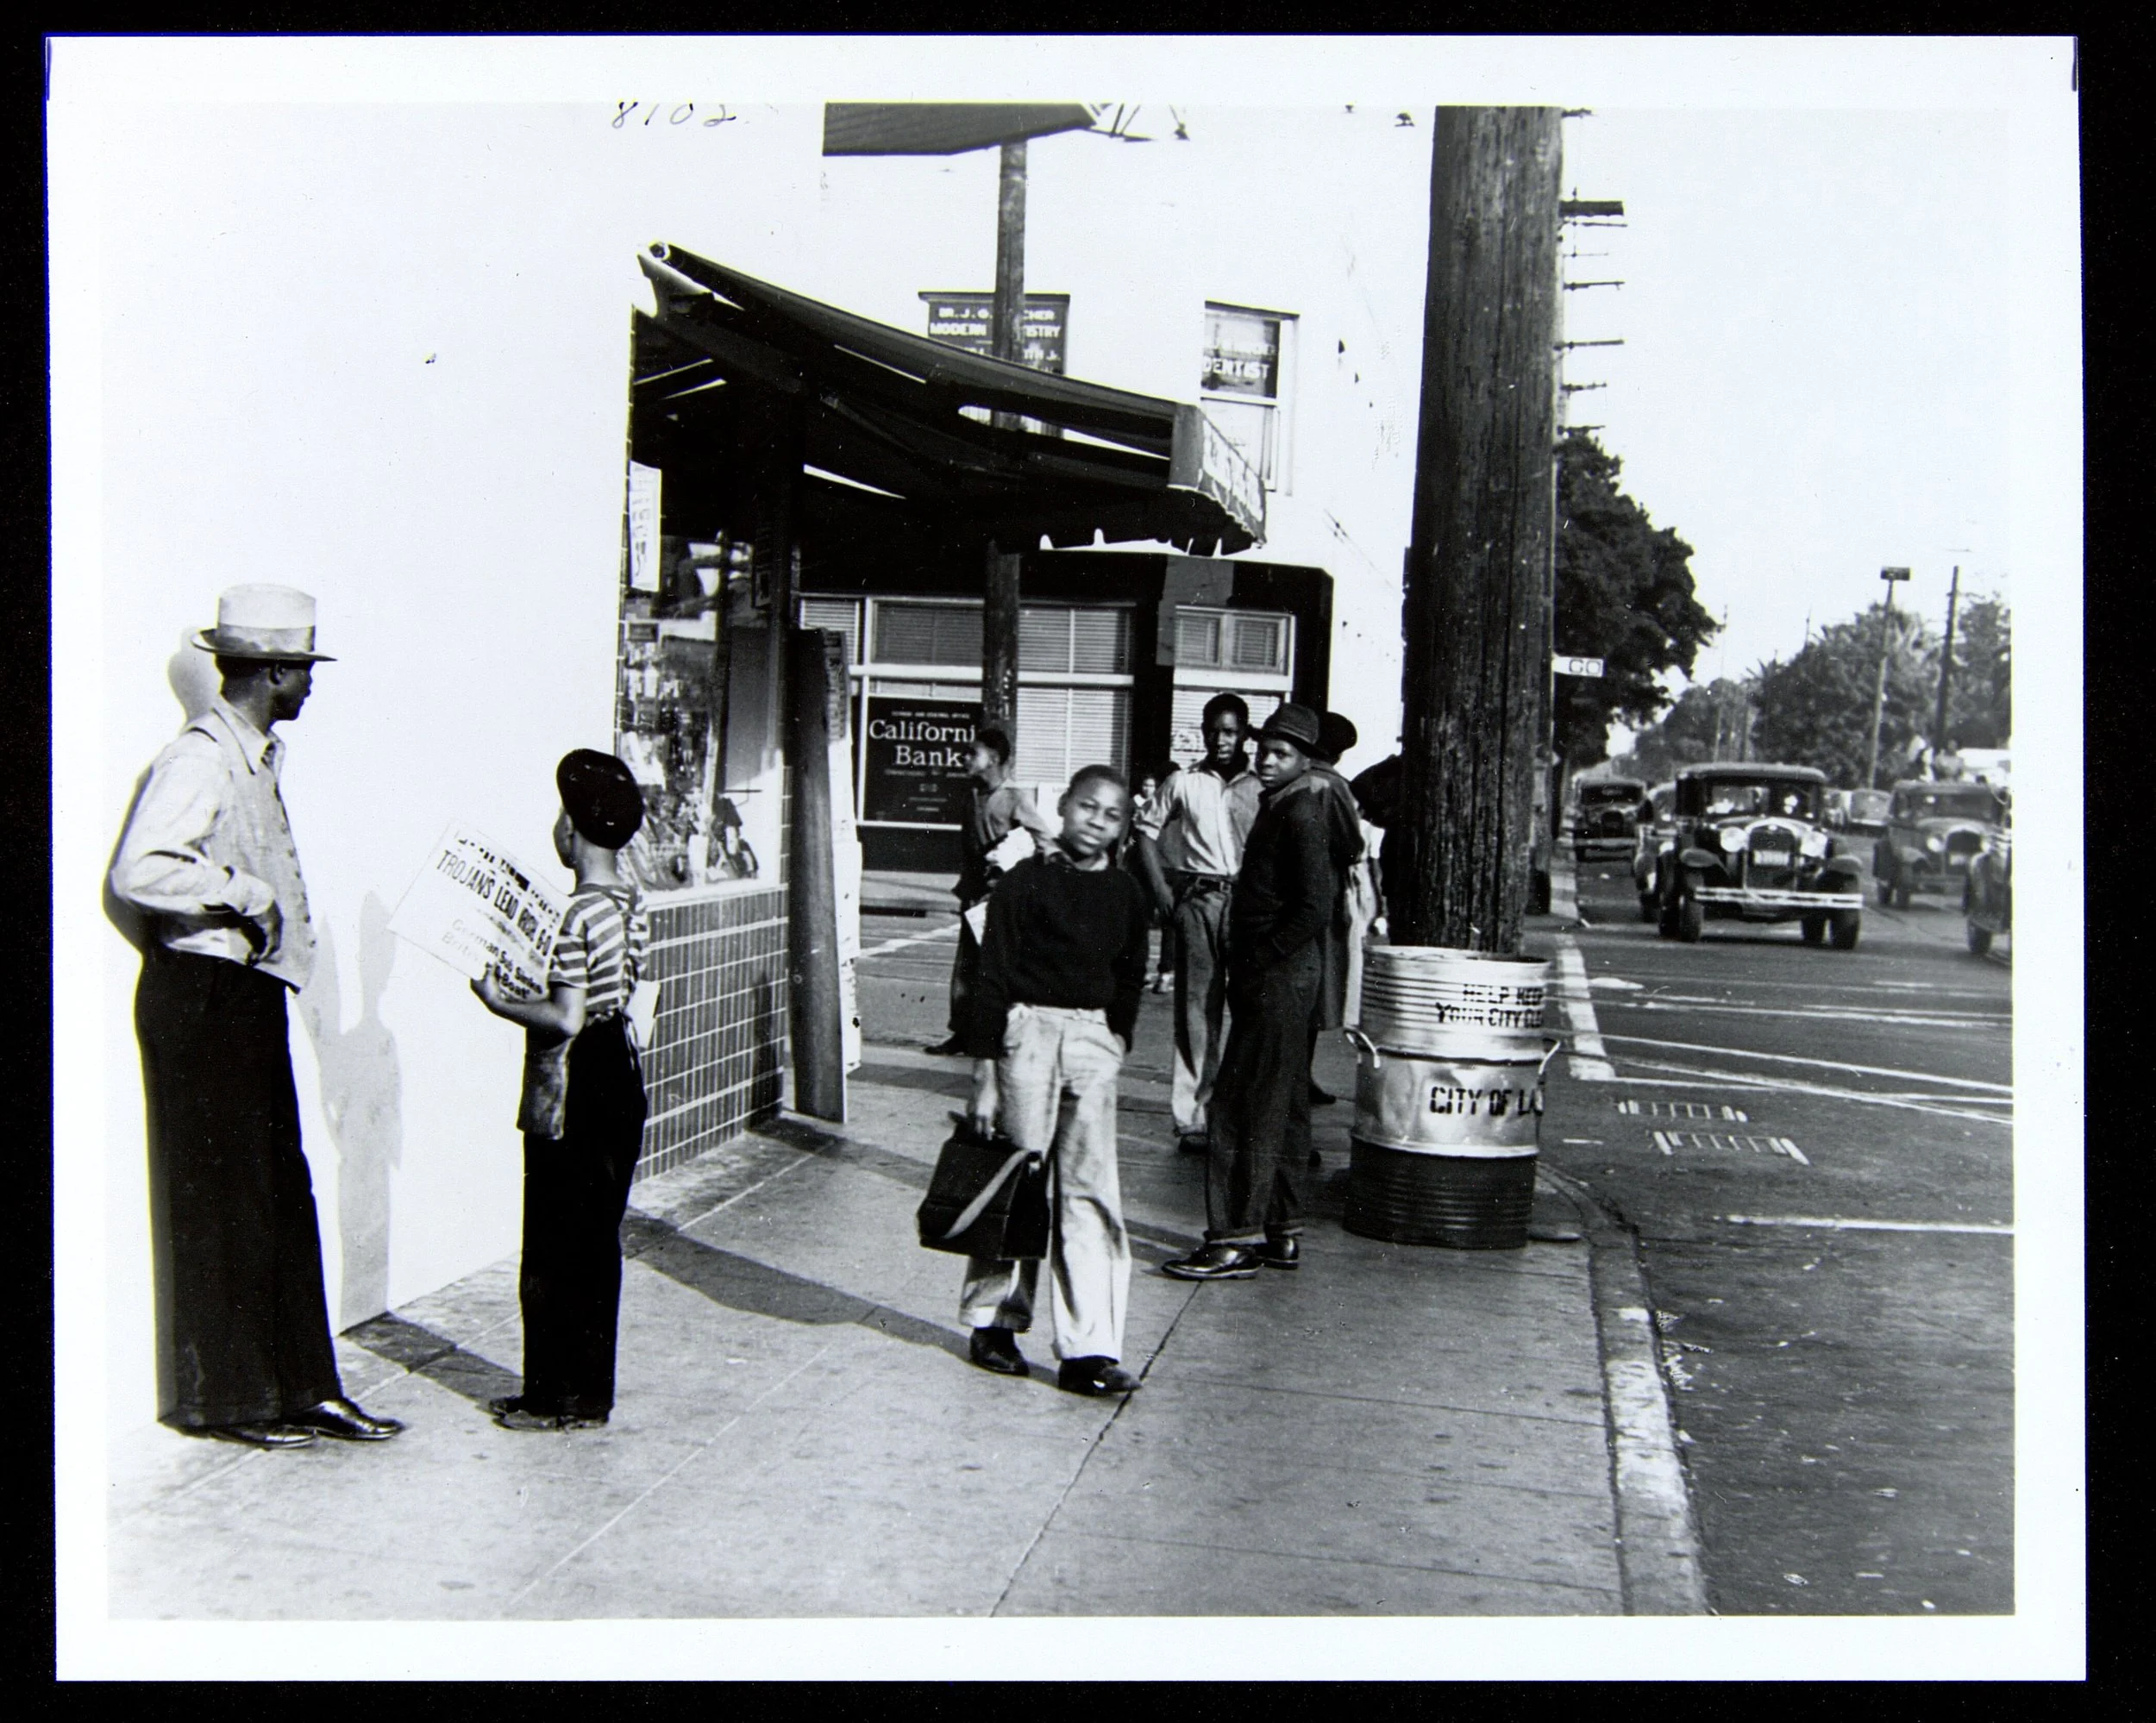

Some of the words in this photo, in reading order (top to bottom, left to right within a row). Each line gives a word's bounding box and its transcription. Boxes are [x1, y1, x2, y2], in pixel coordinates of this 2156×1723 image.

[611, 101, 736, 128] 8102
[929, 323, 987, 336] MODERN
[1202, 355, 1269, 380] DENTIST
[869, 719, 975, 743] Californi
[894, 745, 964, 768] Bank
[436, 849, 496, 899] TROJANS
[1463, 983, 1510, 1005] HELP
[1435, 1002, 1483, 1025] YOUR
[1489, 1007, 1521, 1029] CITY
[1430, 1087, 1483, 1115] CITY
[1489, 1088, 1513, 1116] OF
